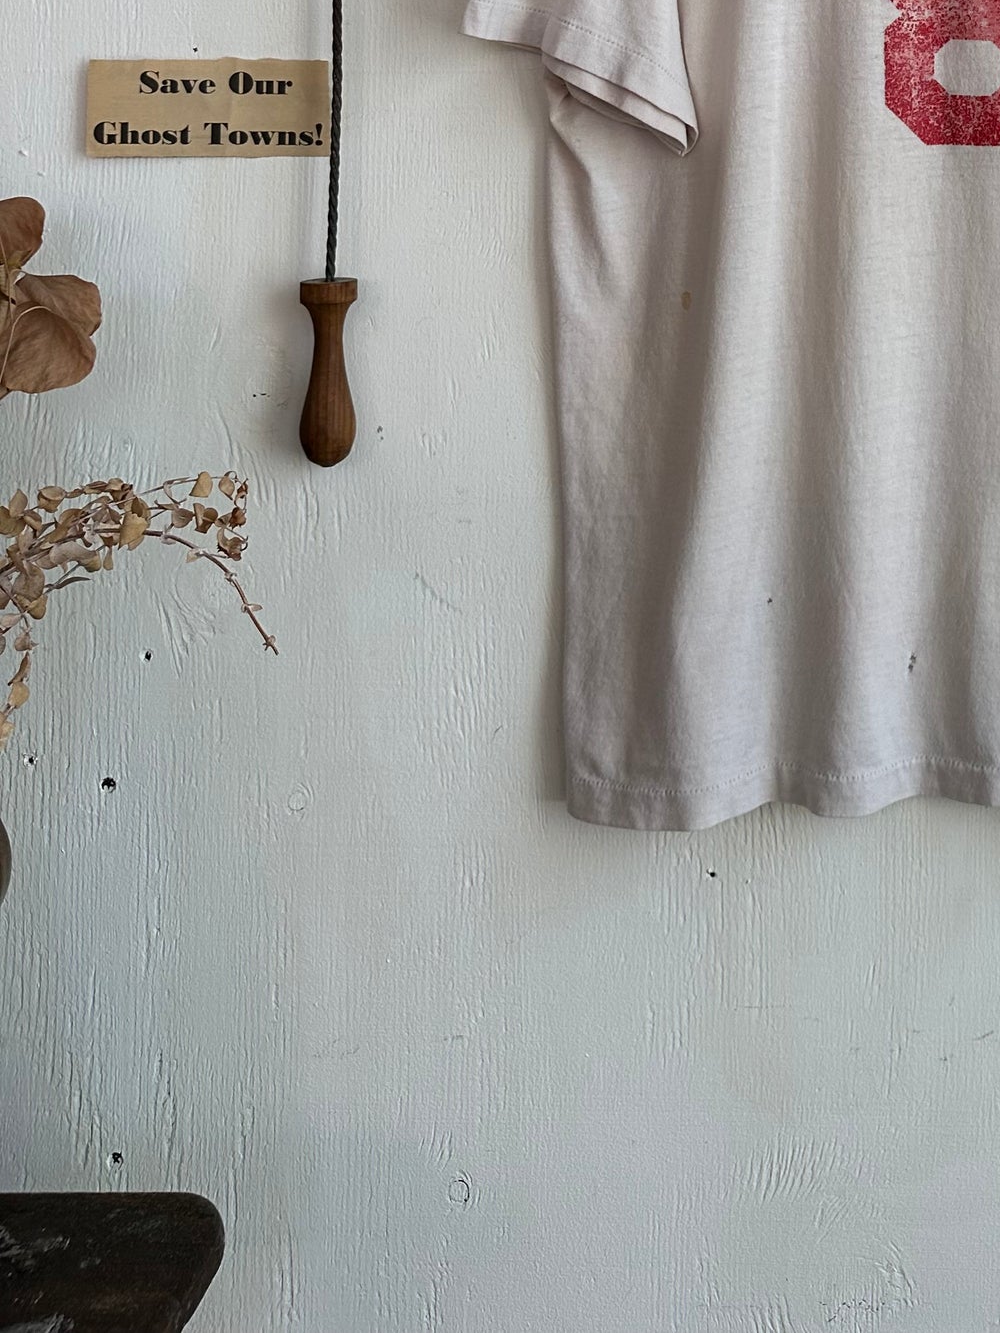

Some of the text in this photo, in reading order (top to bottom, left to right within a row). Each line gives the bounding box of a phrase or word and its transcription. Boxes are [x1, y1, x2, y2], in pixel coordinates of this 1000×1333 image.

[138, 70, 293, 95] Save Our
[93, 121, 324, 146] Ghost Towns!
